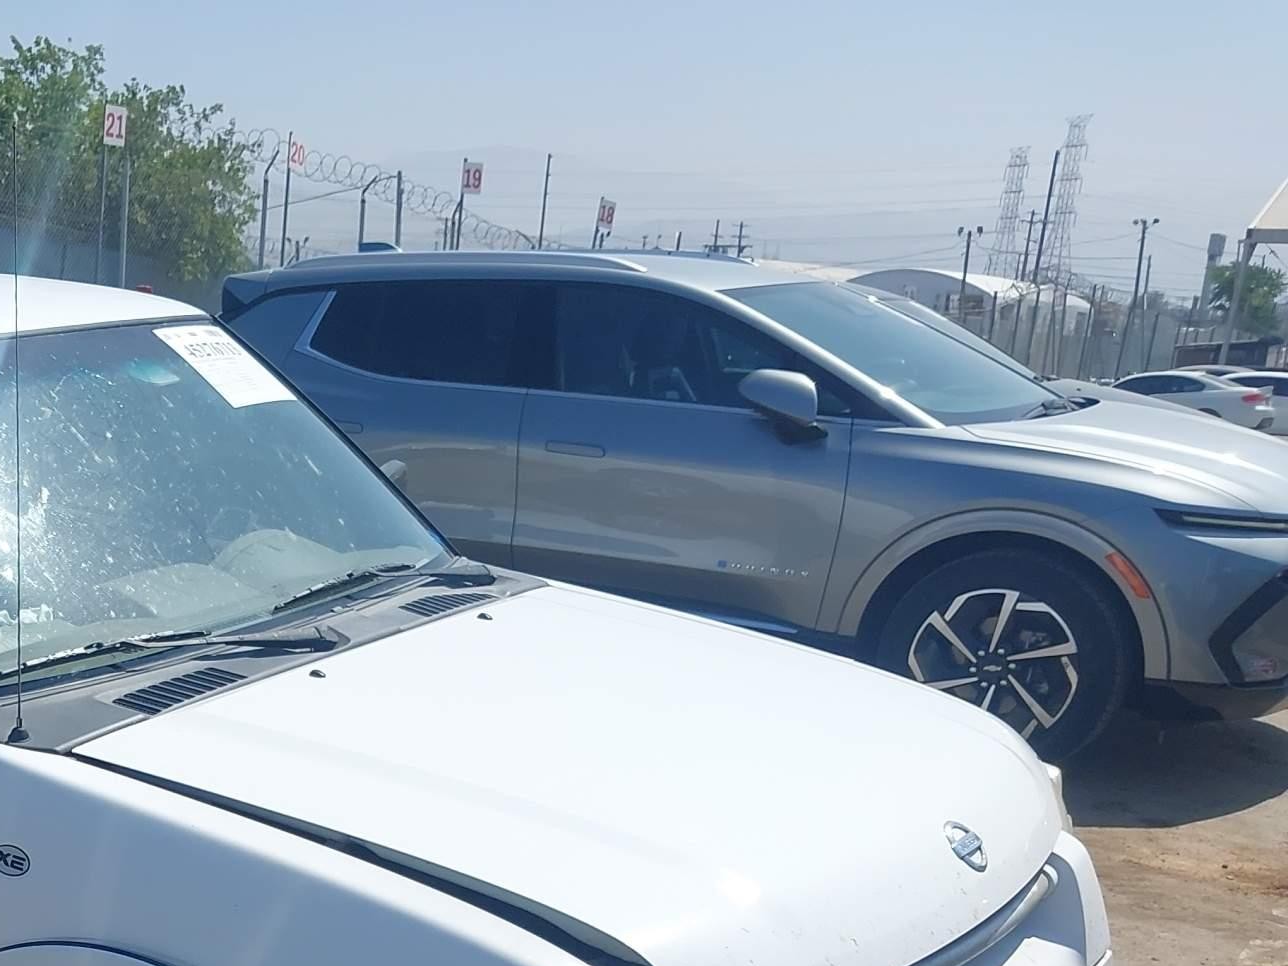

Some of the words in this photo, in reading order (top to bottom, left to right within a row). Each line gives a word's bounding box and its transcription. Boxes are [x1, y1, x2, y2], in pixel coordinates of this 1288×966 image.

[106, 112, 124, 139] 21
[291, 141, 305, 166] 20
[464, 168, 482, 189] 19
[600, 205, 615, 225] 18
